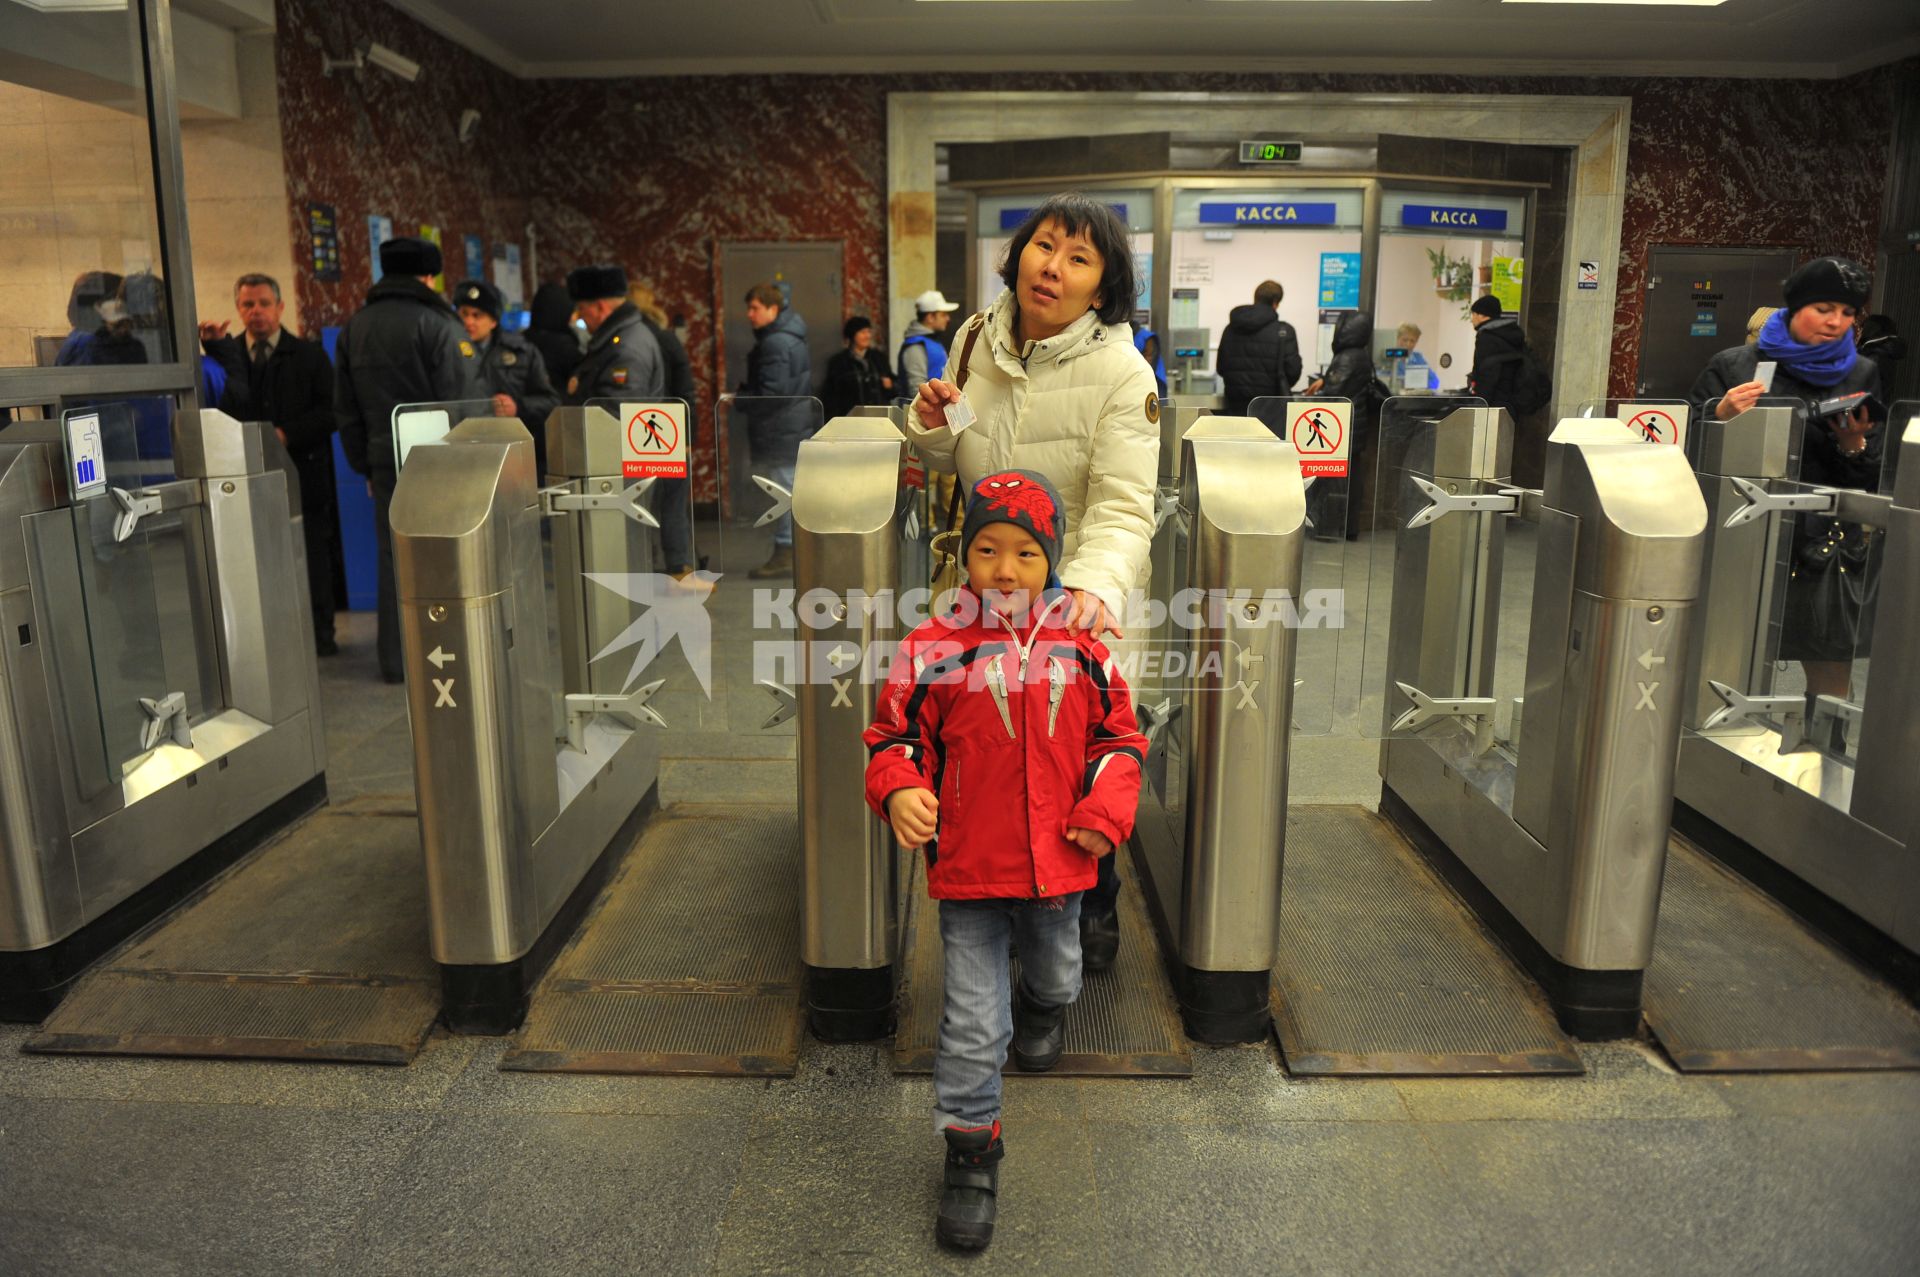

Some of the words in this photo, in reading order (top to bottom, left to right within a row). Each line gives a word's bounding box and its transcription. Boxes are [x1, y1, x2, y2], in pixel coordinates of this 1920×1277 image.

[1235, 206, 1297, 221] КАССА
[1431, 210, 1478, 225] КАССА
[626, 464, 643, 472] Нет
[645, 465, 684, 474] прохода
[1307, 465, 1345, 474] прохода
